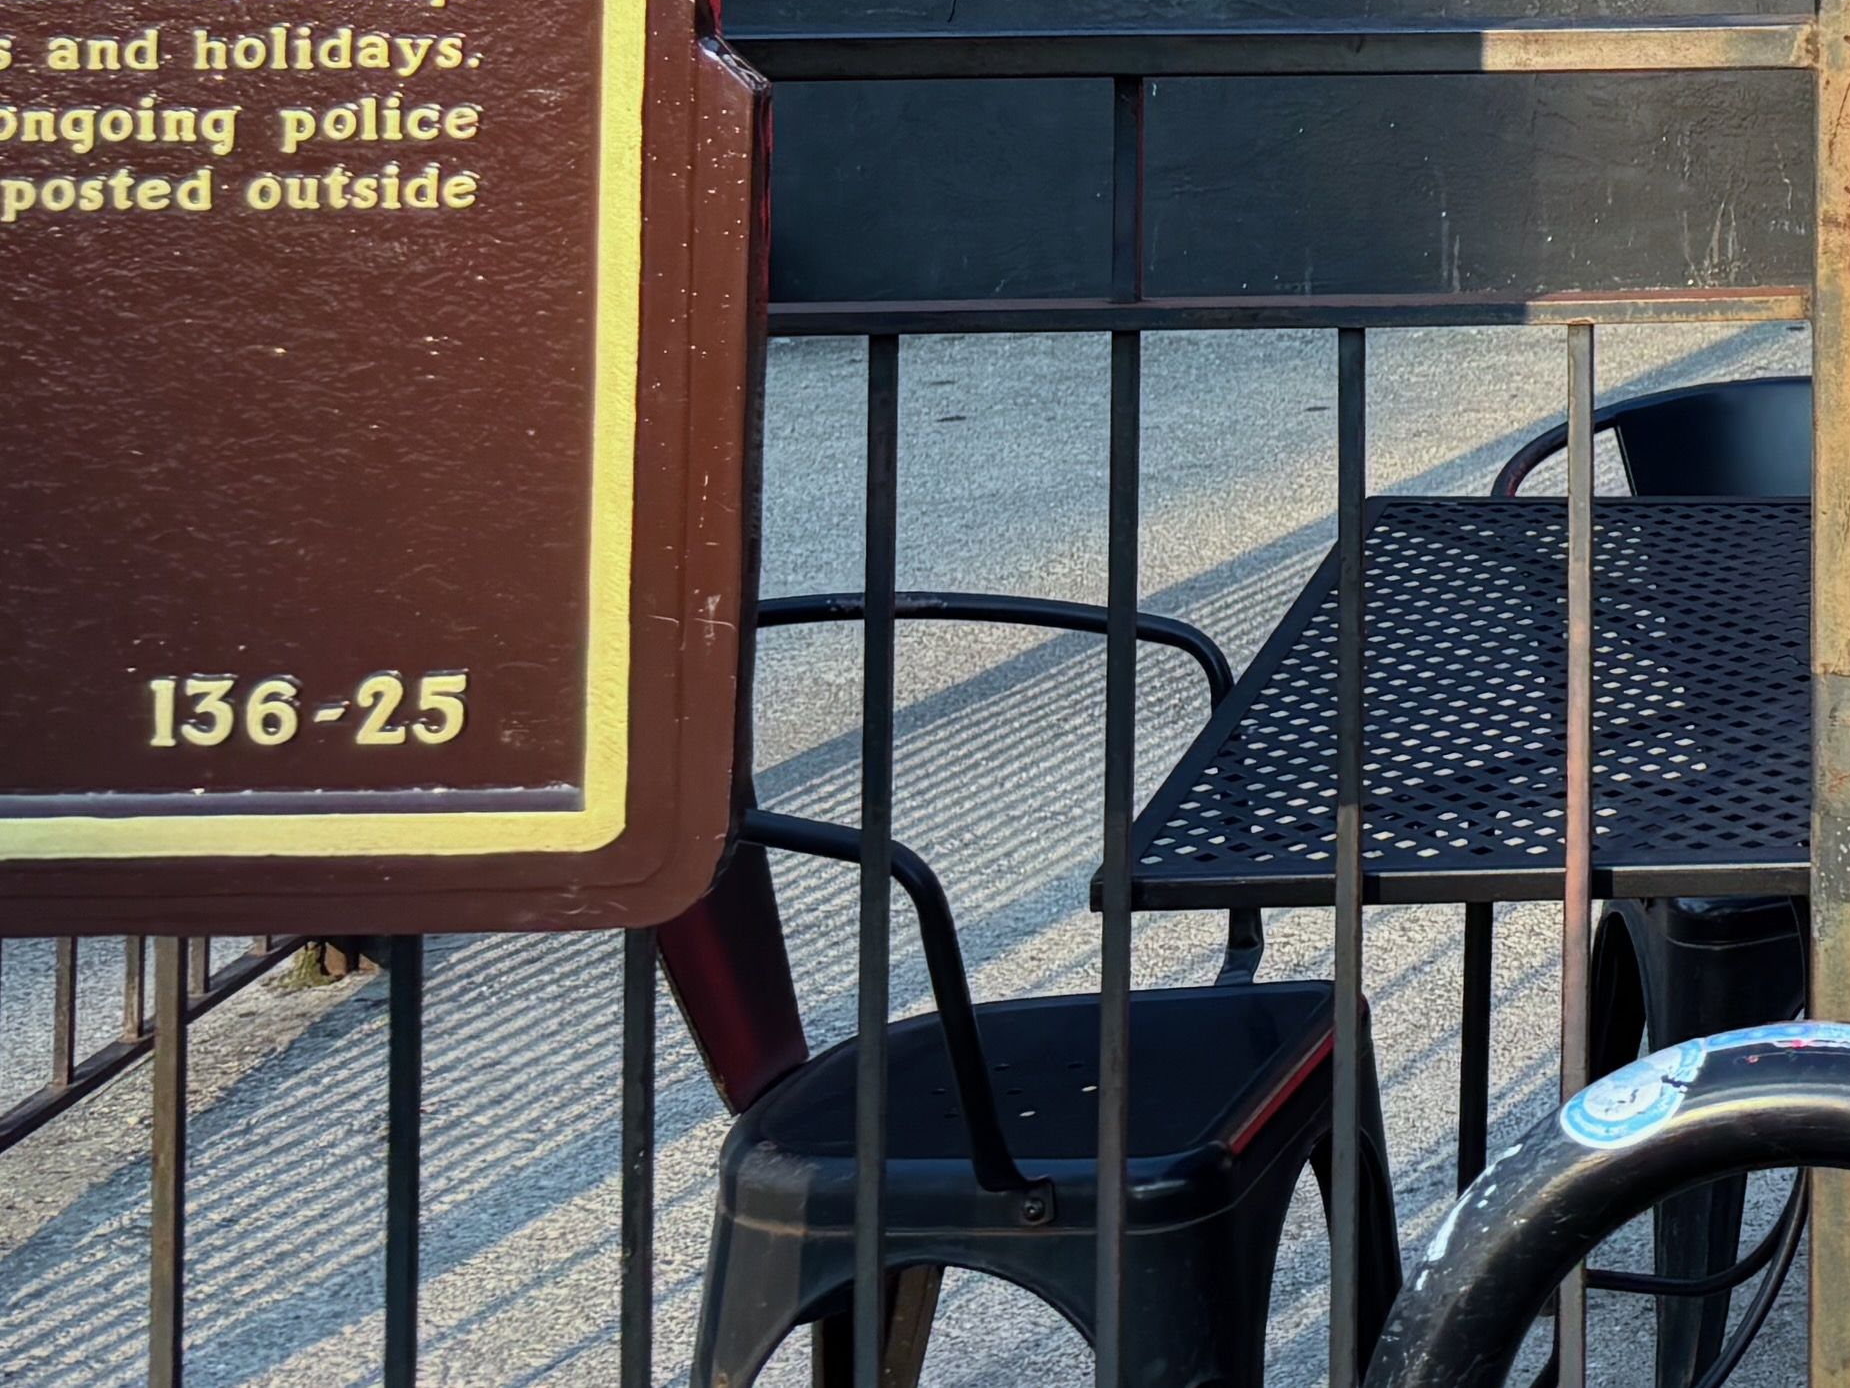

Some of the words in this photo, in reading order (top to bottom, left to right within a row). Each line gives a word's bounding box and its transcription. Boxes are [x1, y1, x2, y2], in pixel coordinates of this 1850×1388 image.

[48, 29, 159, 70] and
[195, 28, 481, 77] holidays.
[282, 98, 480, 153] police
[0, 169, 212, 223] posted
[248, 168, 480, 213] outside
[149, 668, 469, 748] 136-25
